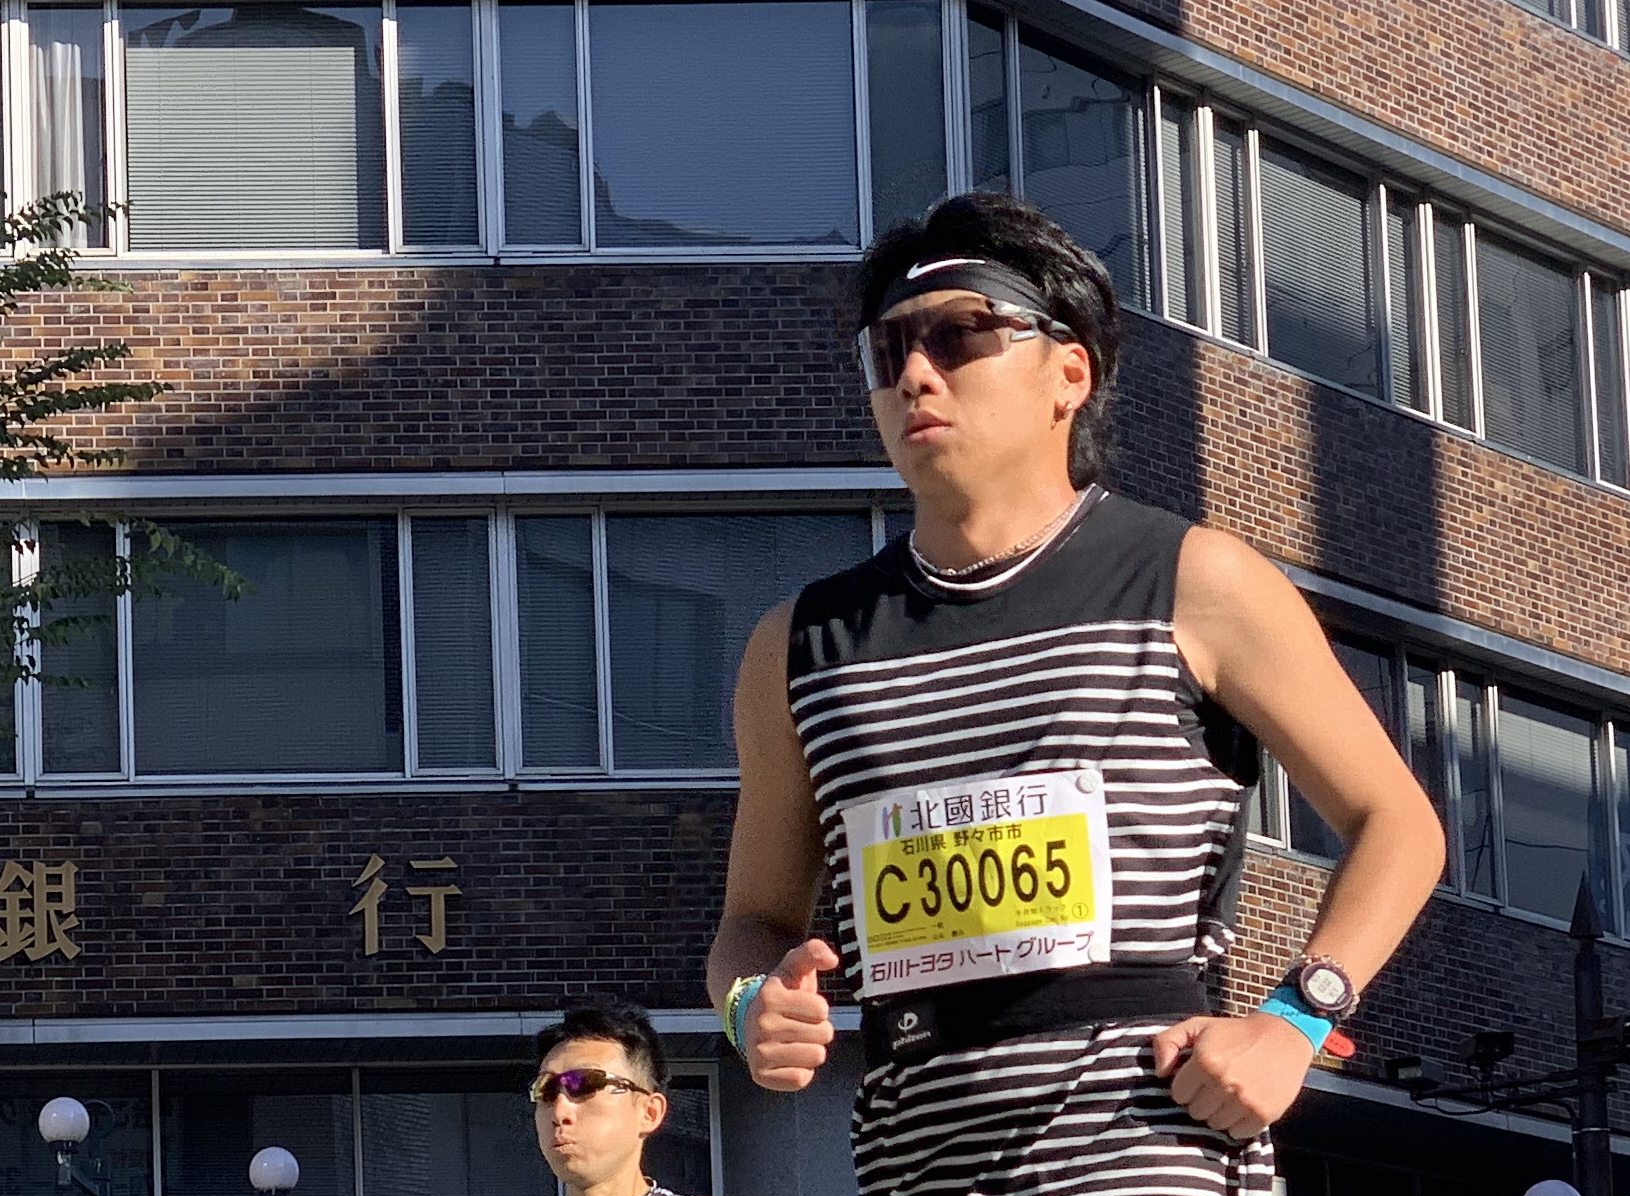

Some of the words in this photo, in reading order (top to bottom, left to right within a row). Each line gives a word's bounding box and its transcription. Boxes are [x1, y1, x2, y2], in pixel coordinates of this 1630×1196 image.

[911, 785, 1048, 831] 北國銀行
[901, 834, 947, 856] 石川県
[954, 823, 1023, 847] 野々市市
[875, 839, 1071, 924] C30065
